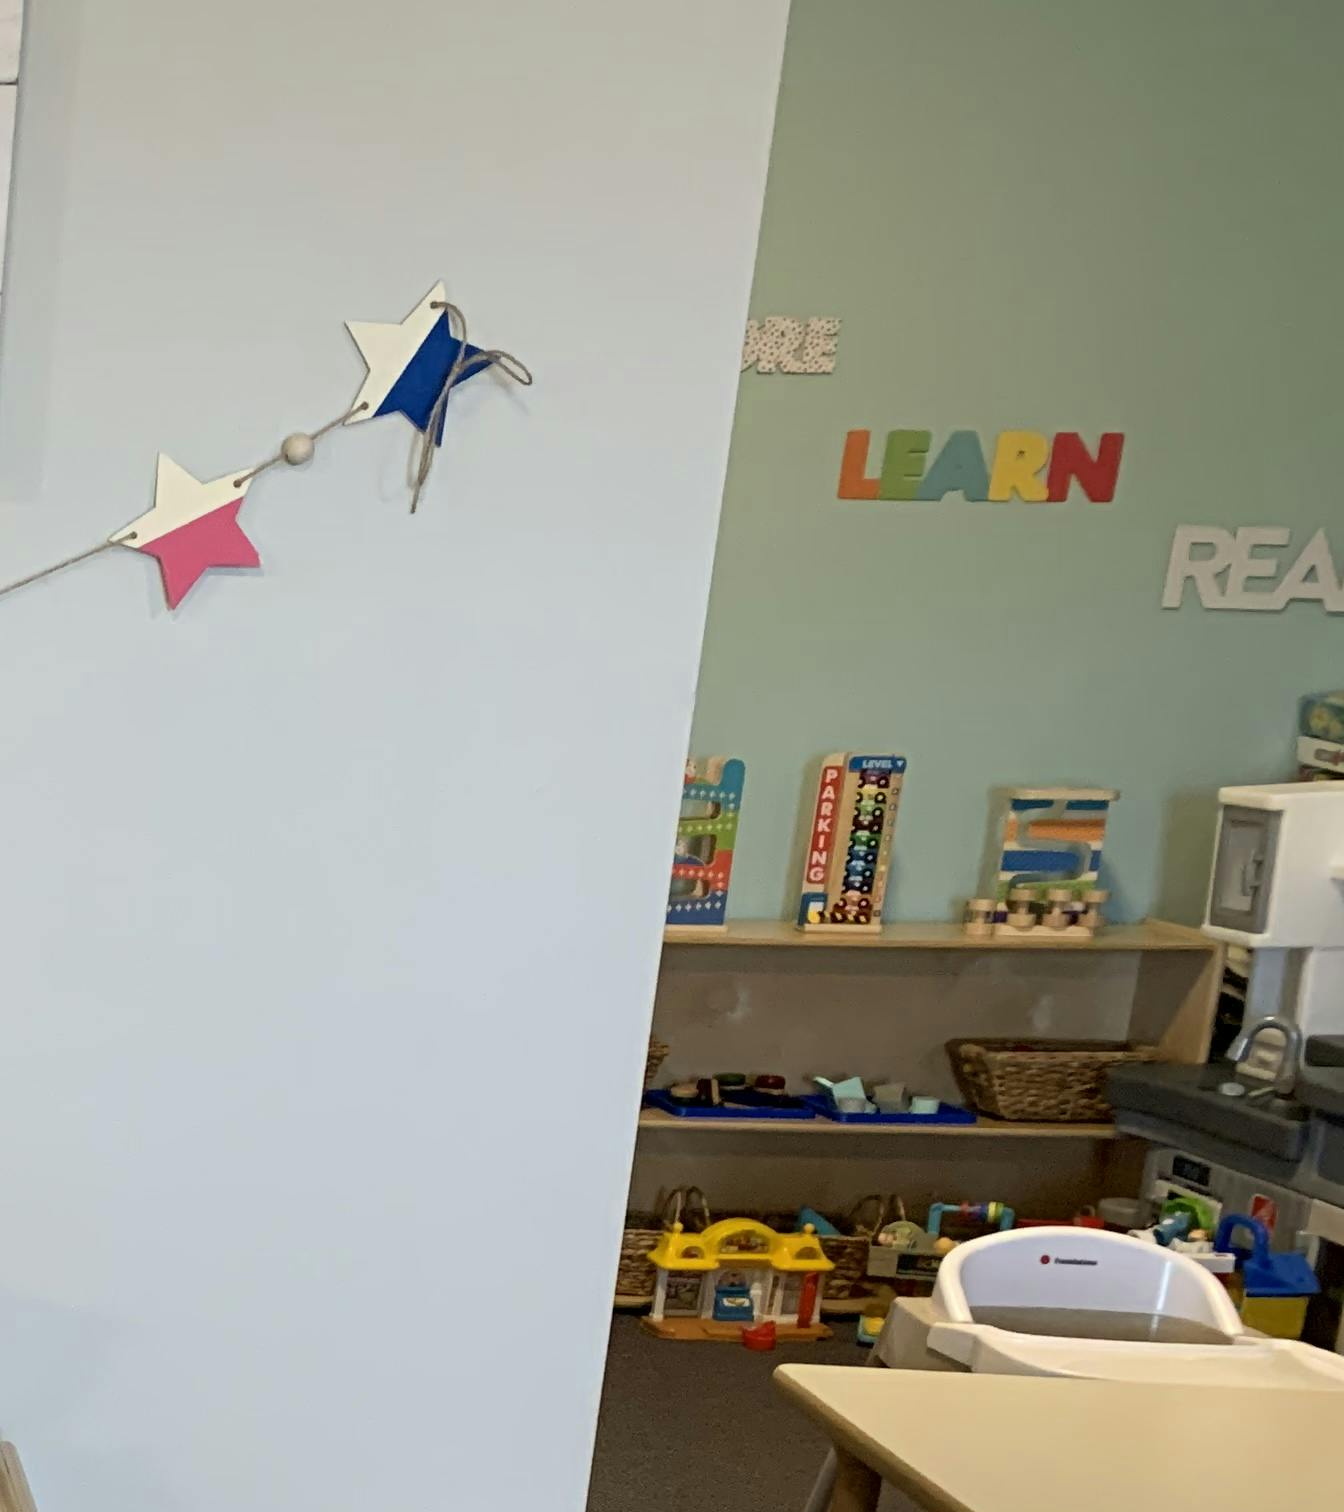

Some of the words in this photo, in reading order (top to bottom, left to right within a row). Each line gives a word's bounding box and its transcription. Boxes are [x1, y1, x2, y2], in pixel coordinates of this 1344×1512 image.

[837, 429, 1125, 502] LEARN
[1161, 524, 1344, 613] REA
[862, 758, 893, 769] LEVEL
[809, 768, 839, 882] PARKING
